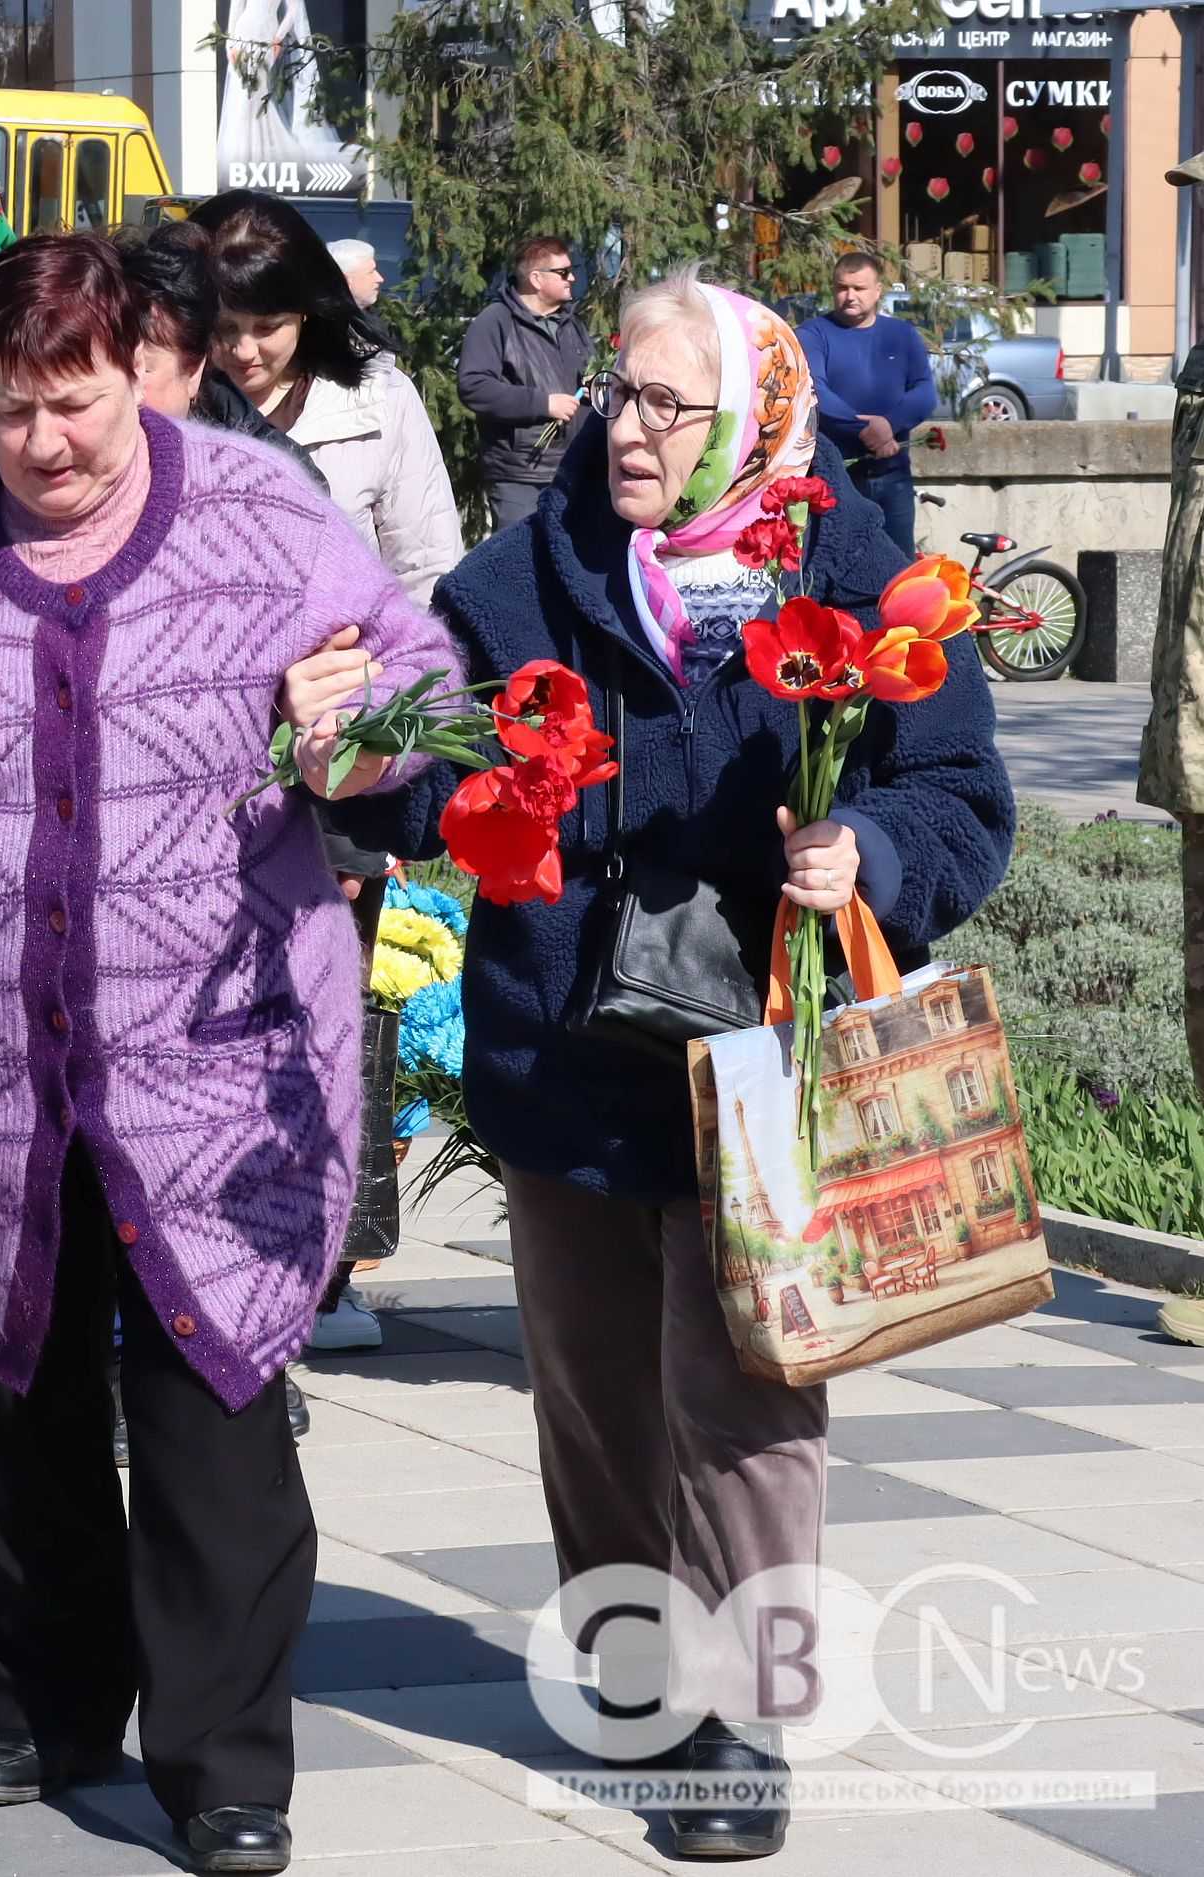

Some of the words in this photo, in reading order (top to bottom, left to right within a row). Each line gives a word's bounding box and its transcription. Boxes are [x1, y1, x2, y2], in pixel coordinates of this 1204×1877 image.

[957, 31, 1011, 50] ЦЕНТР
[916, 85, 965, 98] BORSA
[228, 162, 300, 193] ВХІД
